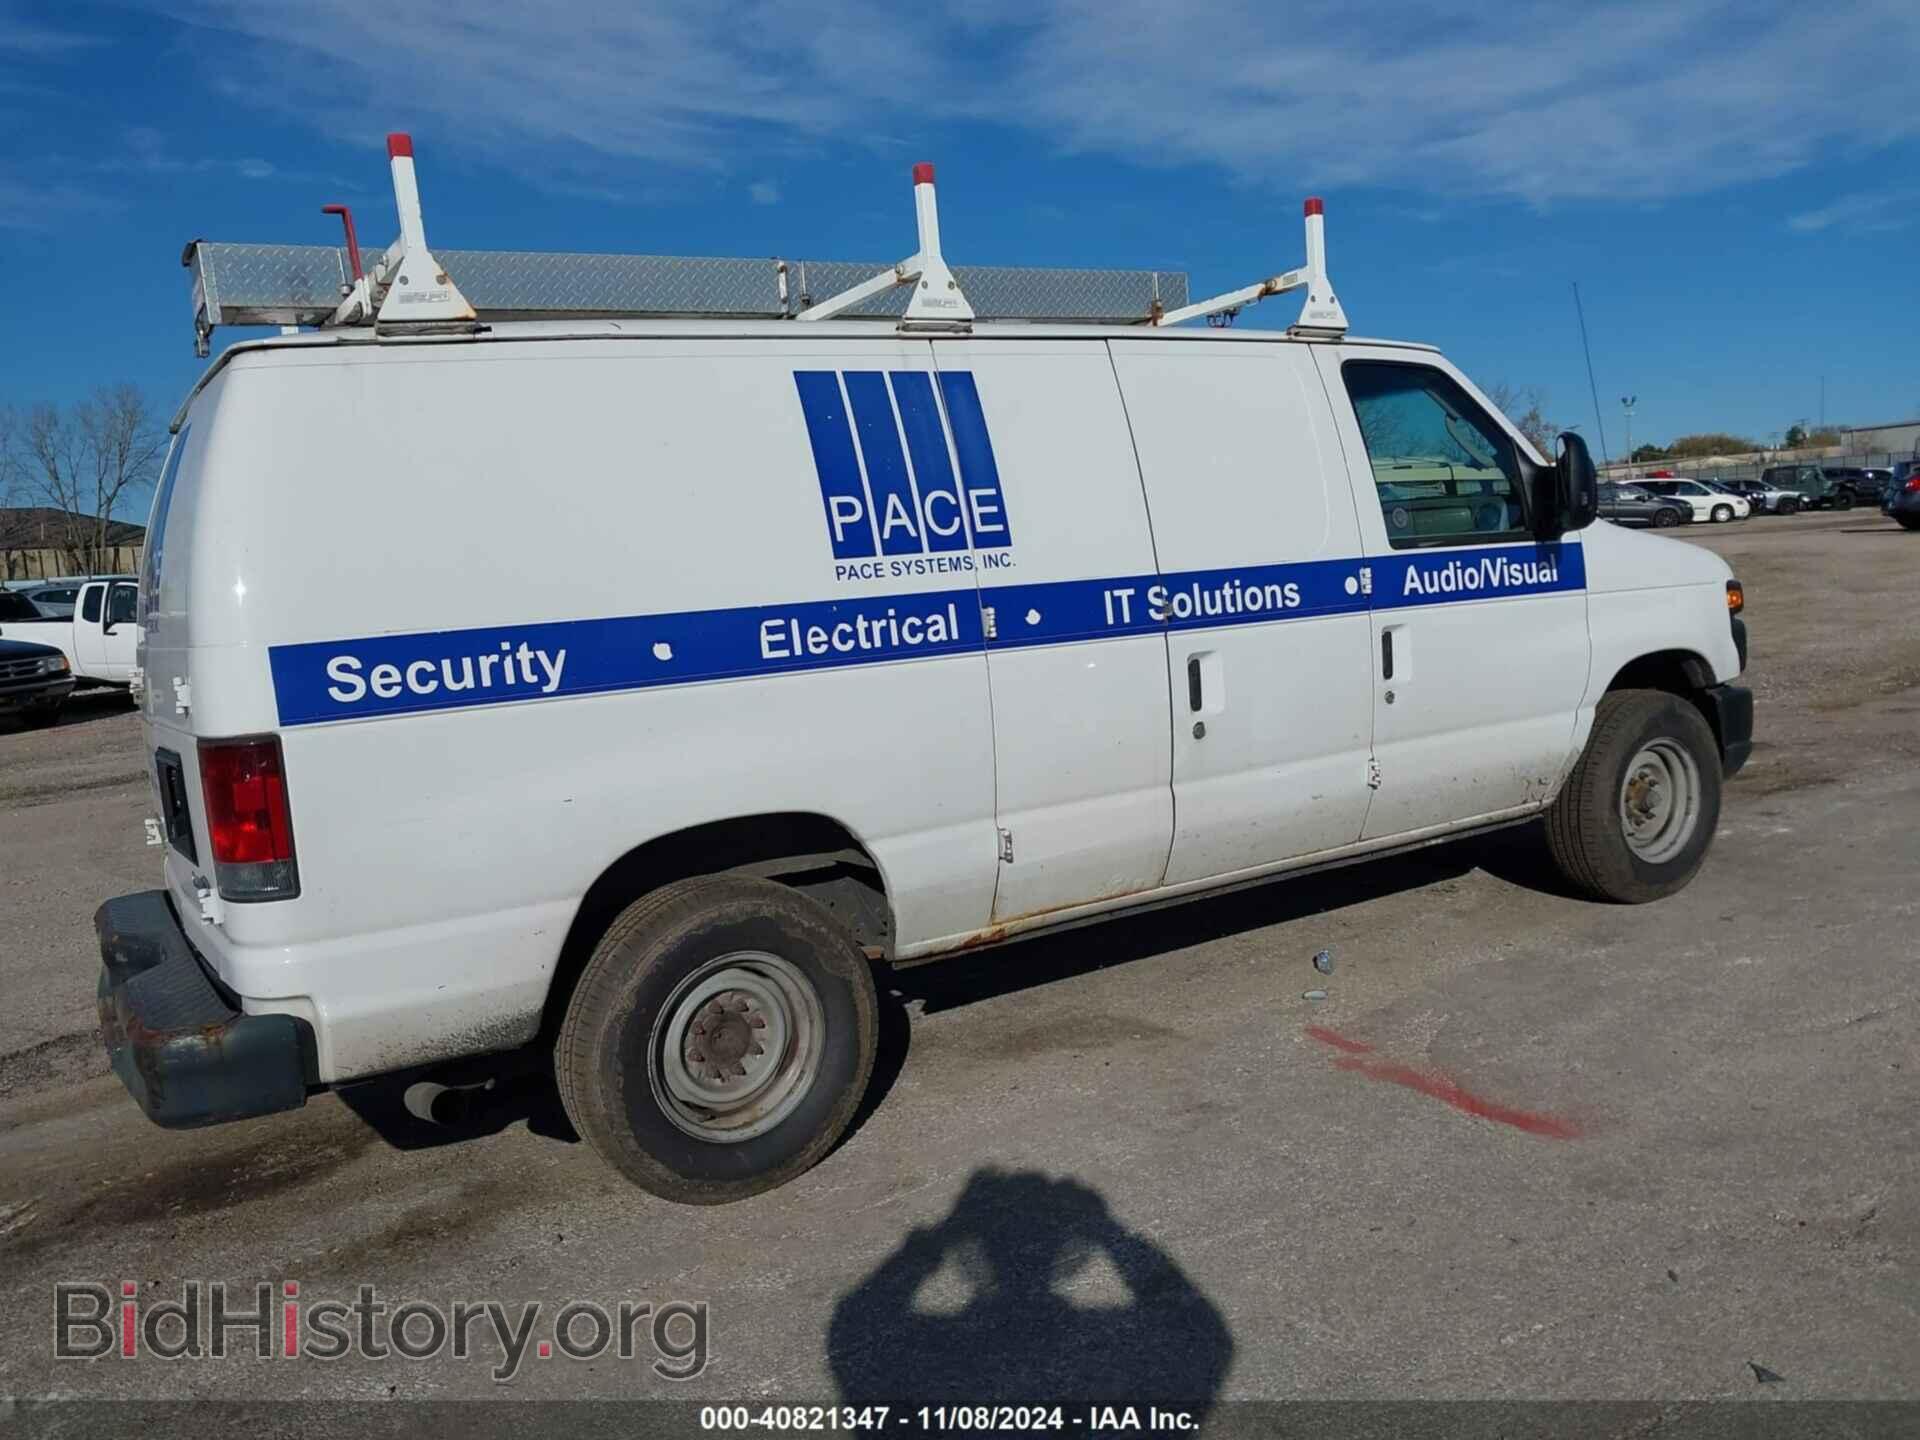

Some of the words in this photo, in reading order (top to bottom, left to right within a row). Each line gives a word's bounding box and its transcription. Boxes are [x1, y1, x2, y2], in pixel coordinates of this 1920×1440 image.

[829, 488, 1004, 542] PACE
[835, 562, 885, 581] PACE
[891, 555, 979, 577] SYSTEMS,
[983, 552, 1017, 570] INC.
[326, 641, 567, 702] Security
[760, 603, 959, 659] Electrical
[1104, 588, 1135, 625] IT
[1147, 579, 1301, 620] Solutions
[1403, 553, 1559, 596] Audio/Visual
